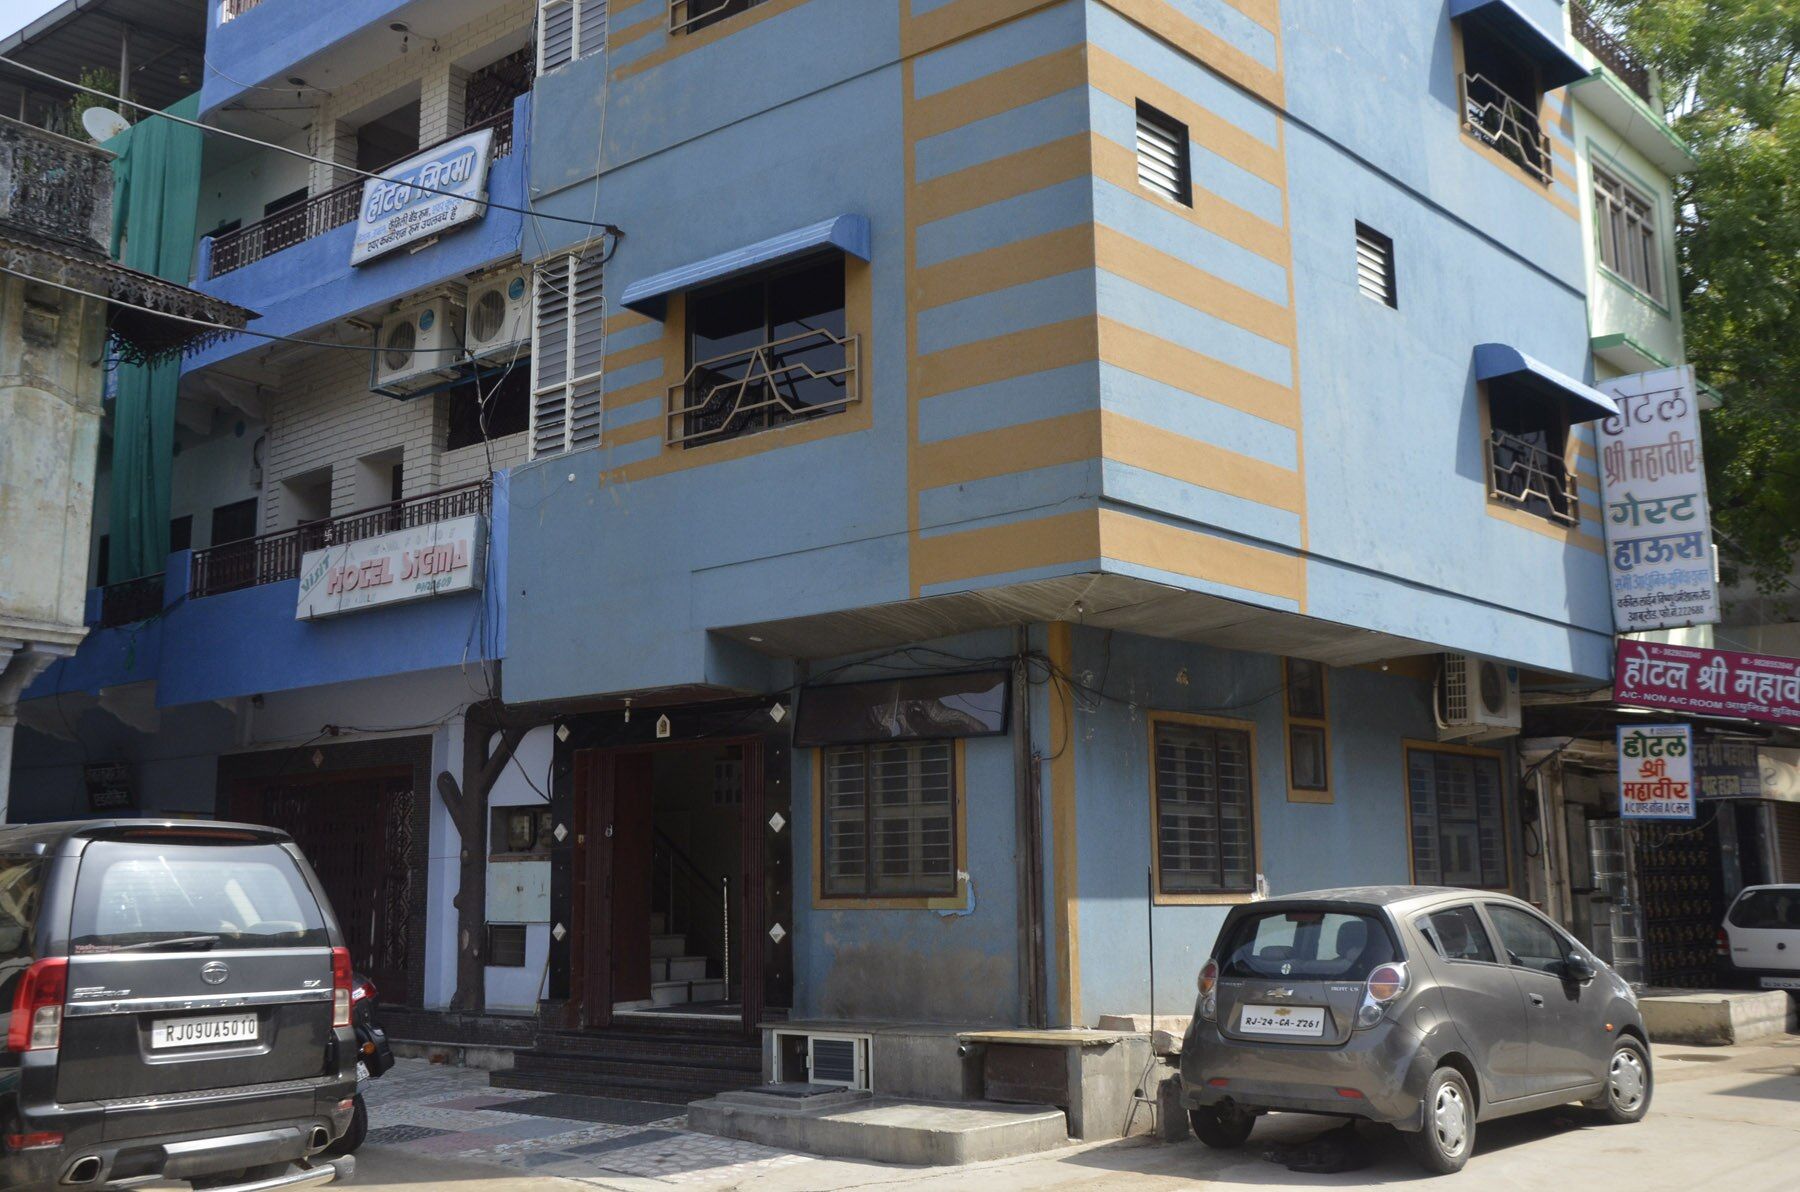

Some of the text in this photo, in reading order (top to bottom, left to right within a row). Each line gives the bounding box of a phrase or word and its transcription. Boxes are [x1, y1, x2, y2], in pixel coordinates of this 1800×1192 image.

[366, 176, 416, 223] होटल
[1604, 431, 1696, 487] श्री महावीर
[1610, 492, 1697, 527] गेस्ट
[1614, 531, 1704, 571] हाऊस
[327, 557, 394, 595] HOTEL
[1624, 646, 1690, 689] होटल
[1696, 656, 1728, 694] श्री
[1643, 693, 1667, 702] NON
[1668, 695, 1687, 705] A/C
[1690, 698, 1722, 709] ROOM
[1623, 730, 1687, 758] होटल
[1639, 759, 1666, 778] श्री
[1623, 777, 1688, 801] महावीर
[166, 1018, 256, 1042] RJ09UA5010
